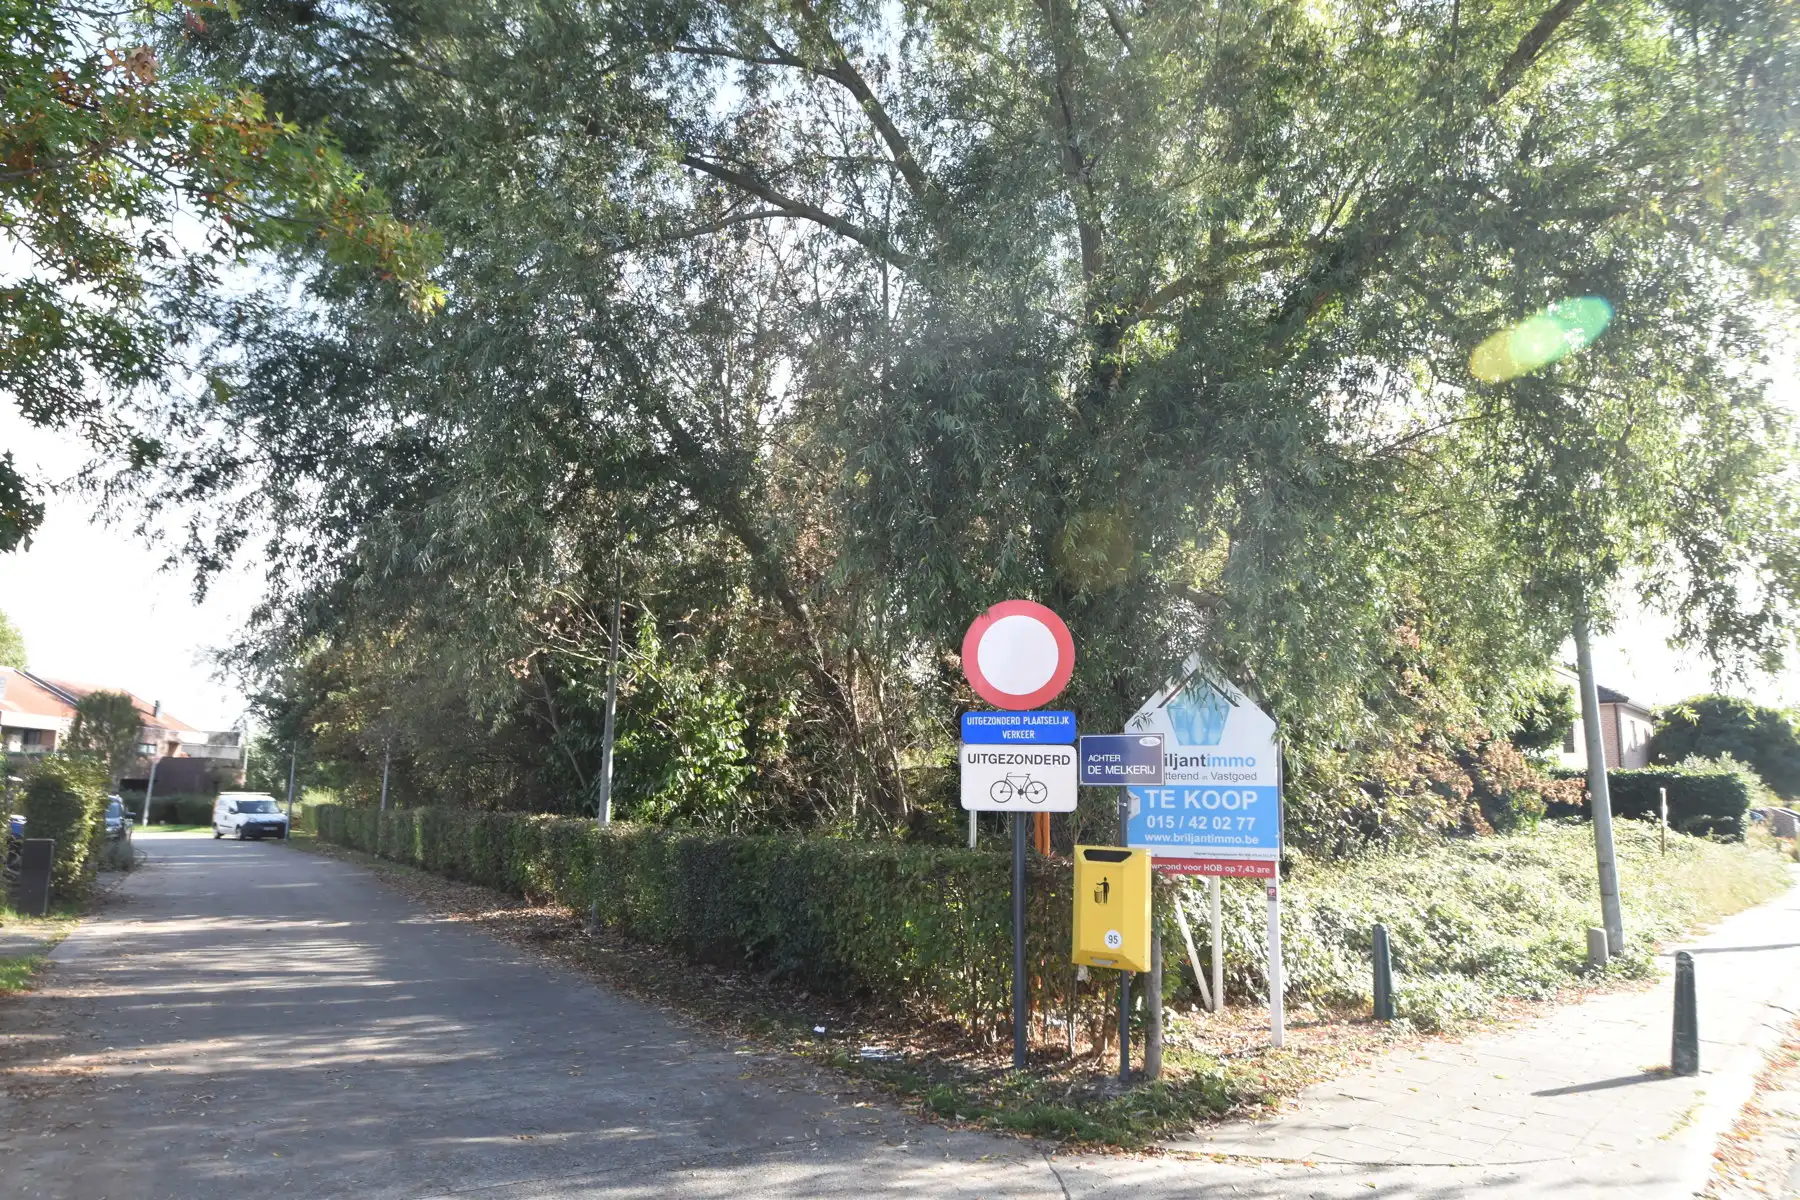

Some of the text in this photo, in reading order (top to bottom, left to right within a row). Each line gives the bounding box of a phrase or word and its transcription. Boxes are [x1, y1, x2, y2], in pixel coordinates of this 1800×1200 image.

[967, 716, 1070, 725] UITGEZONDERD PLAATSELIJK
[1002, 730, 1035, 739] VERKEER
[967, 753, 1071, 765] UITGEZONDERD
[1088, 754, 1121, 762] ACHTER
[1164, 753, 1256, 770] iljantimmo
[1087, 765, 1156, 775] DE MELKERIJ
[1165, 771, 1199, 781] tterend
[1211, 771, 1258, 783] Vastgoed
[1144, 790, 1258, 811] TE KOOP
[1147, 815, 1175, 828] 015
[1189, 816, 1208, 829] 42
[1212, 817, 1232, 830] 02
[1236, 817, 1256, 831] 77
[1145, 833, 1259, 844] www.briljantimmo.be
[1183, 864, 1202, 872] voor
[1203, 864, 1222, 872] HOB
[1108, 935, 1119, 945] 95
